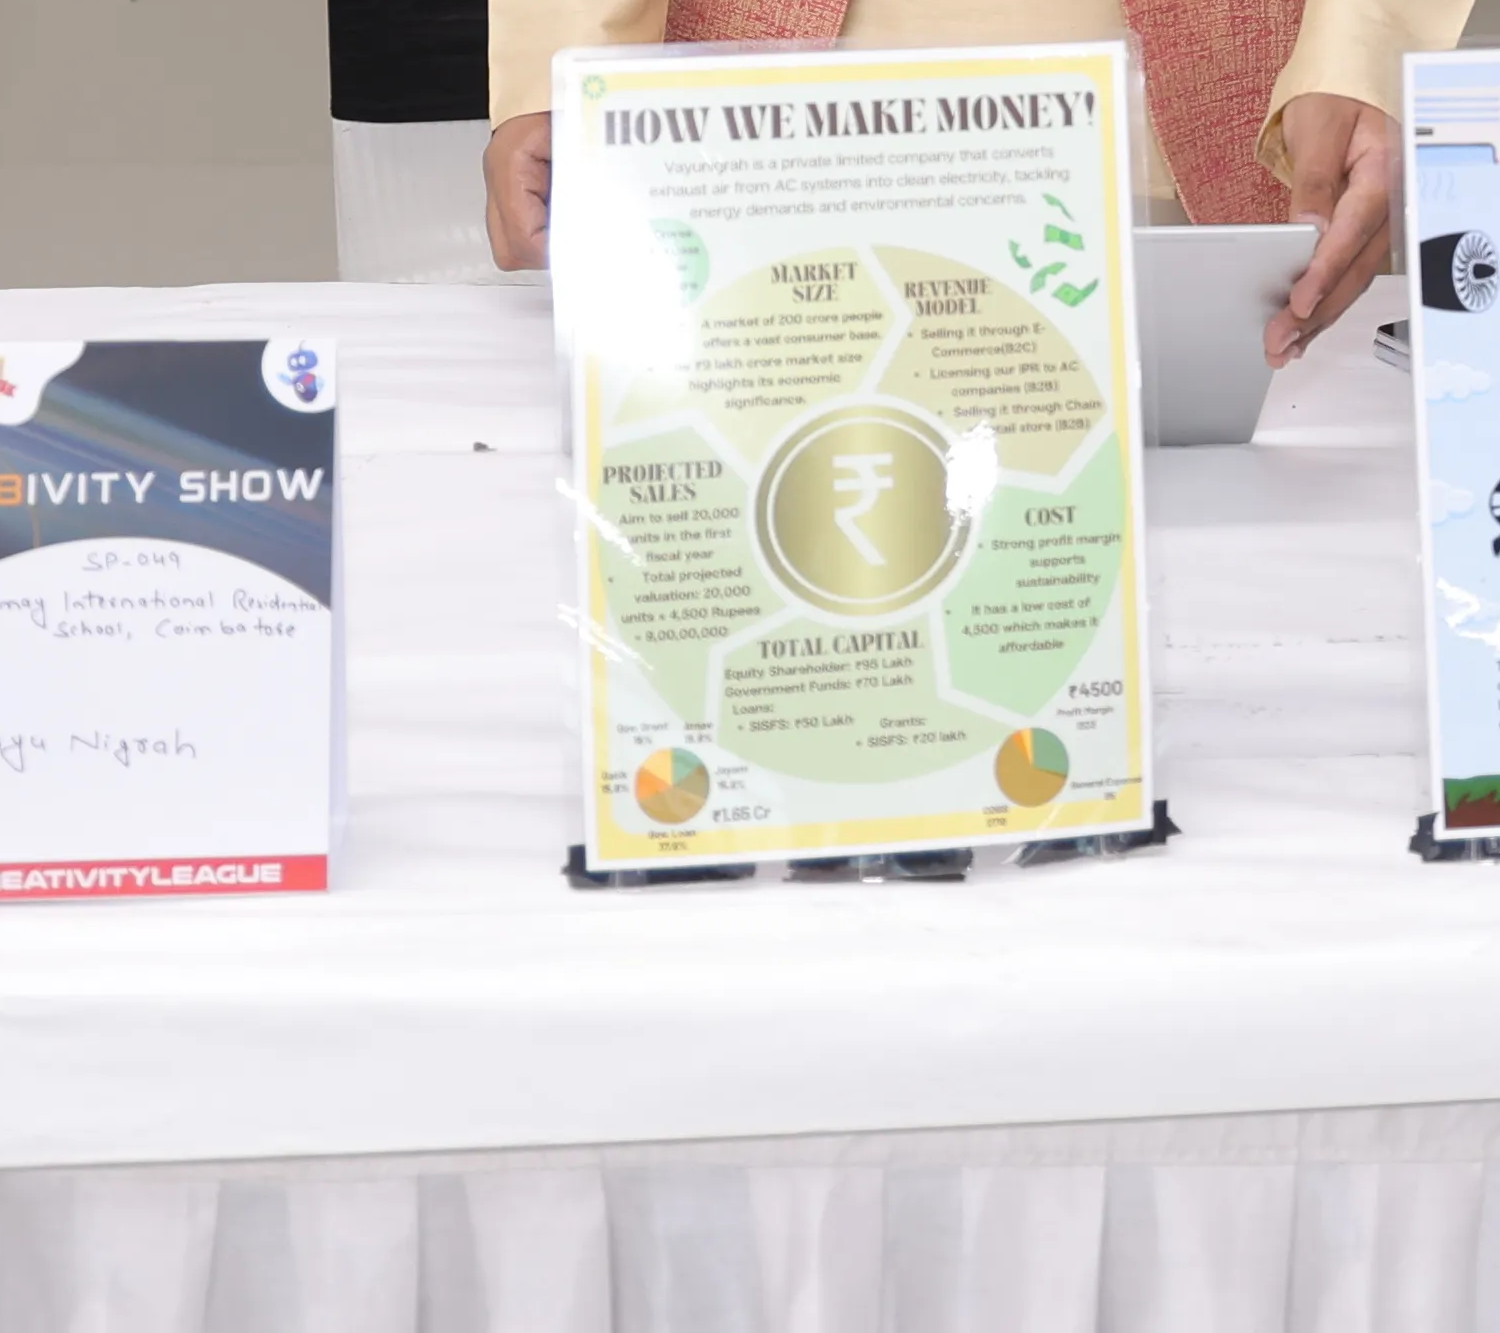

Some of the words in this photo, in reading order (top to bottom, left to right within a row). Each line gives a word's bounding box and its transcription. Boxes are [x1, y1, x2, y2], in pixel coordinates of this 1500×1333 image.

[605, 107, 709, 143] HOW
[722, 104, 794, 139] WE
[806, 99, 926, 136] MAKE
[937, 92, 1096, 131] MONEY!
[771, 261, 858, 284] MARKET
[792, 283, 838, 302] SIZE
[904, 277, 991, 301] REVENUE
[915, 297, 980, 316] MODEL
[179, 469, 324, 502] SHOW
[628, 481, 696, 502] SALES
[1024, 505, 1075, 525] COST
[759, 636, 828, 660] TOTAL
[831, 630, 926, 654] CAPITAL
